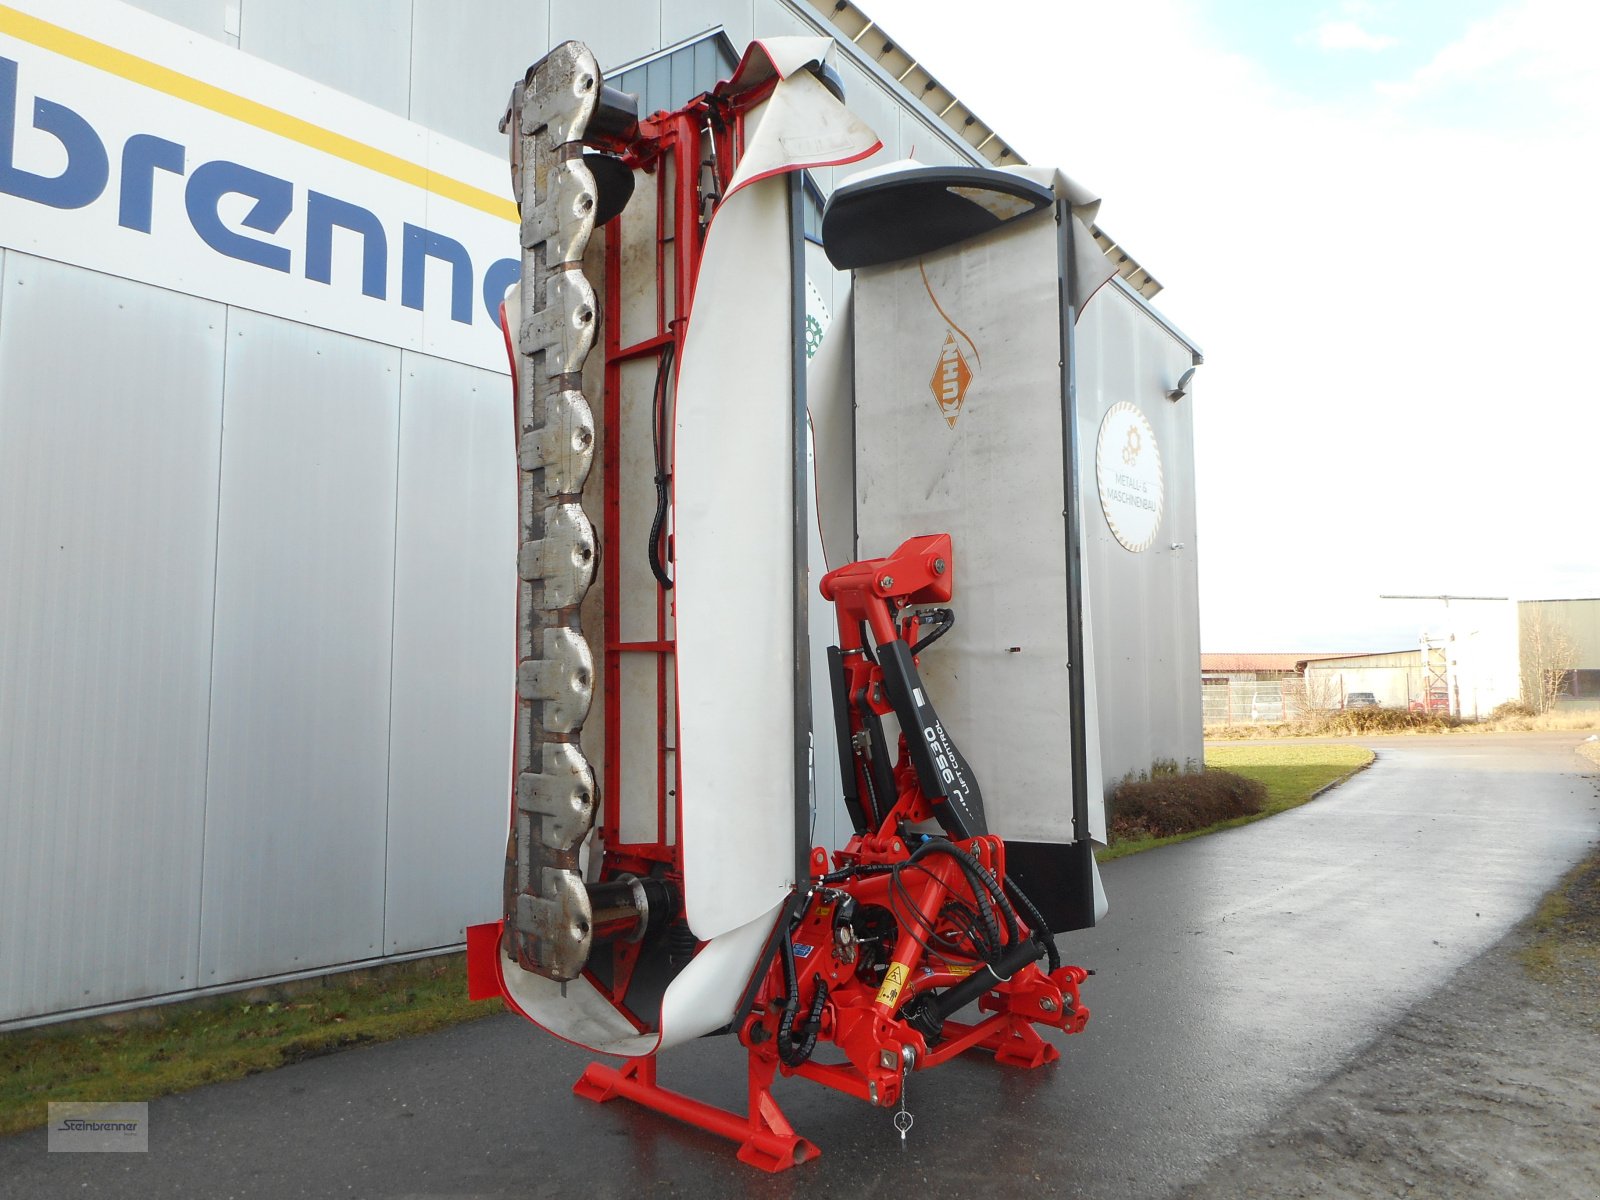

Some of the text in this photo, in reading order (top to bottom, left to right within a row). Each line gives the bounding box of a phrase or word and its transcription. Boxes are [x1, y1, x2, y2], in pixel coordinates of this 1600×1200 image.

[942, 343, 960, 419] KUHN
[1107, 487, 1157, 513] MASCHINENBAU
[924, 726, 955, 785] 9530
[935, 719, 970, 795] LIFT CONTROL
